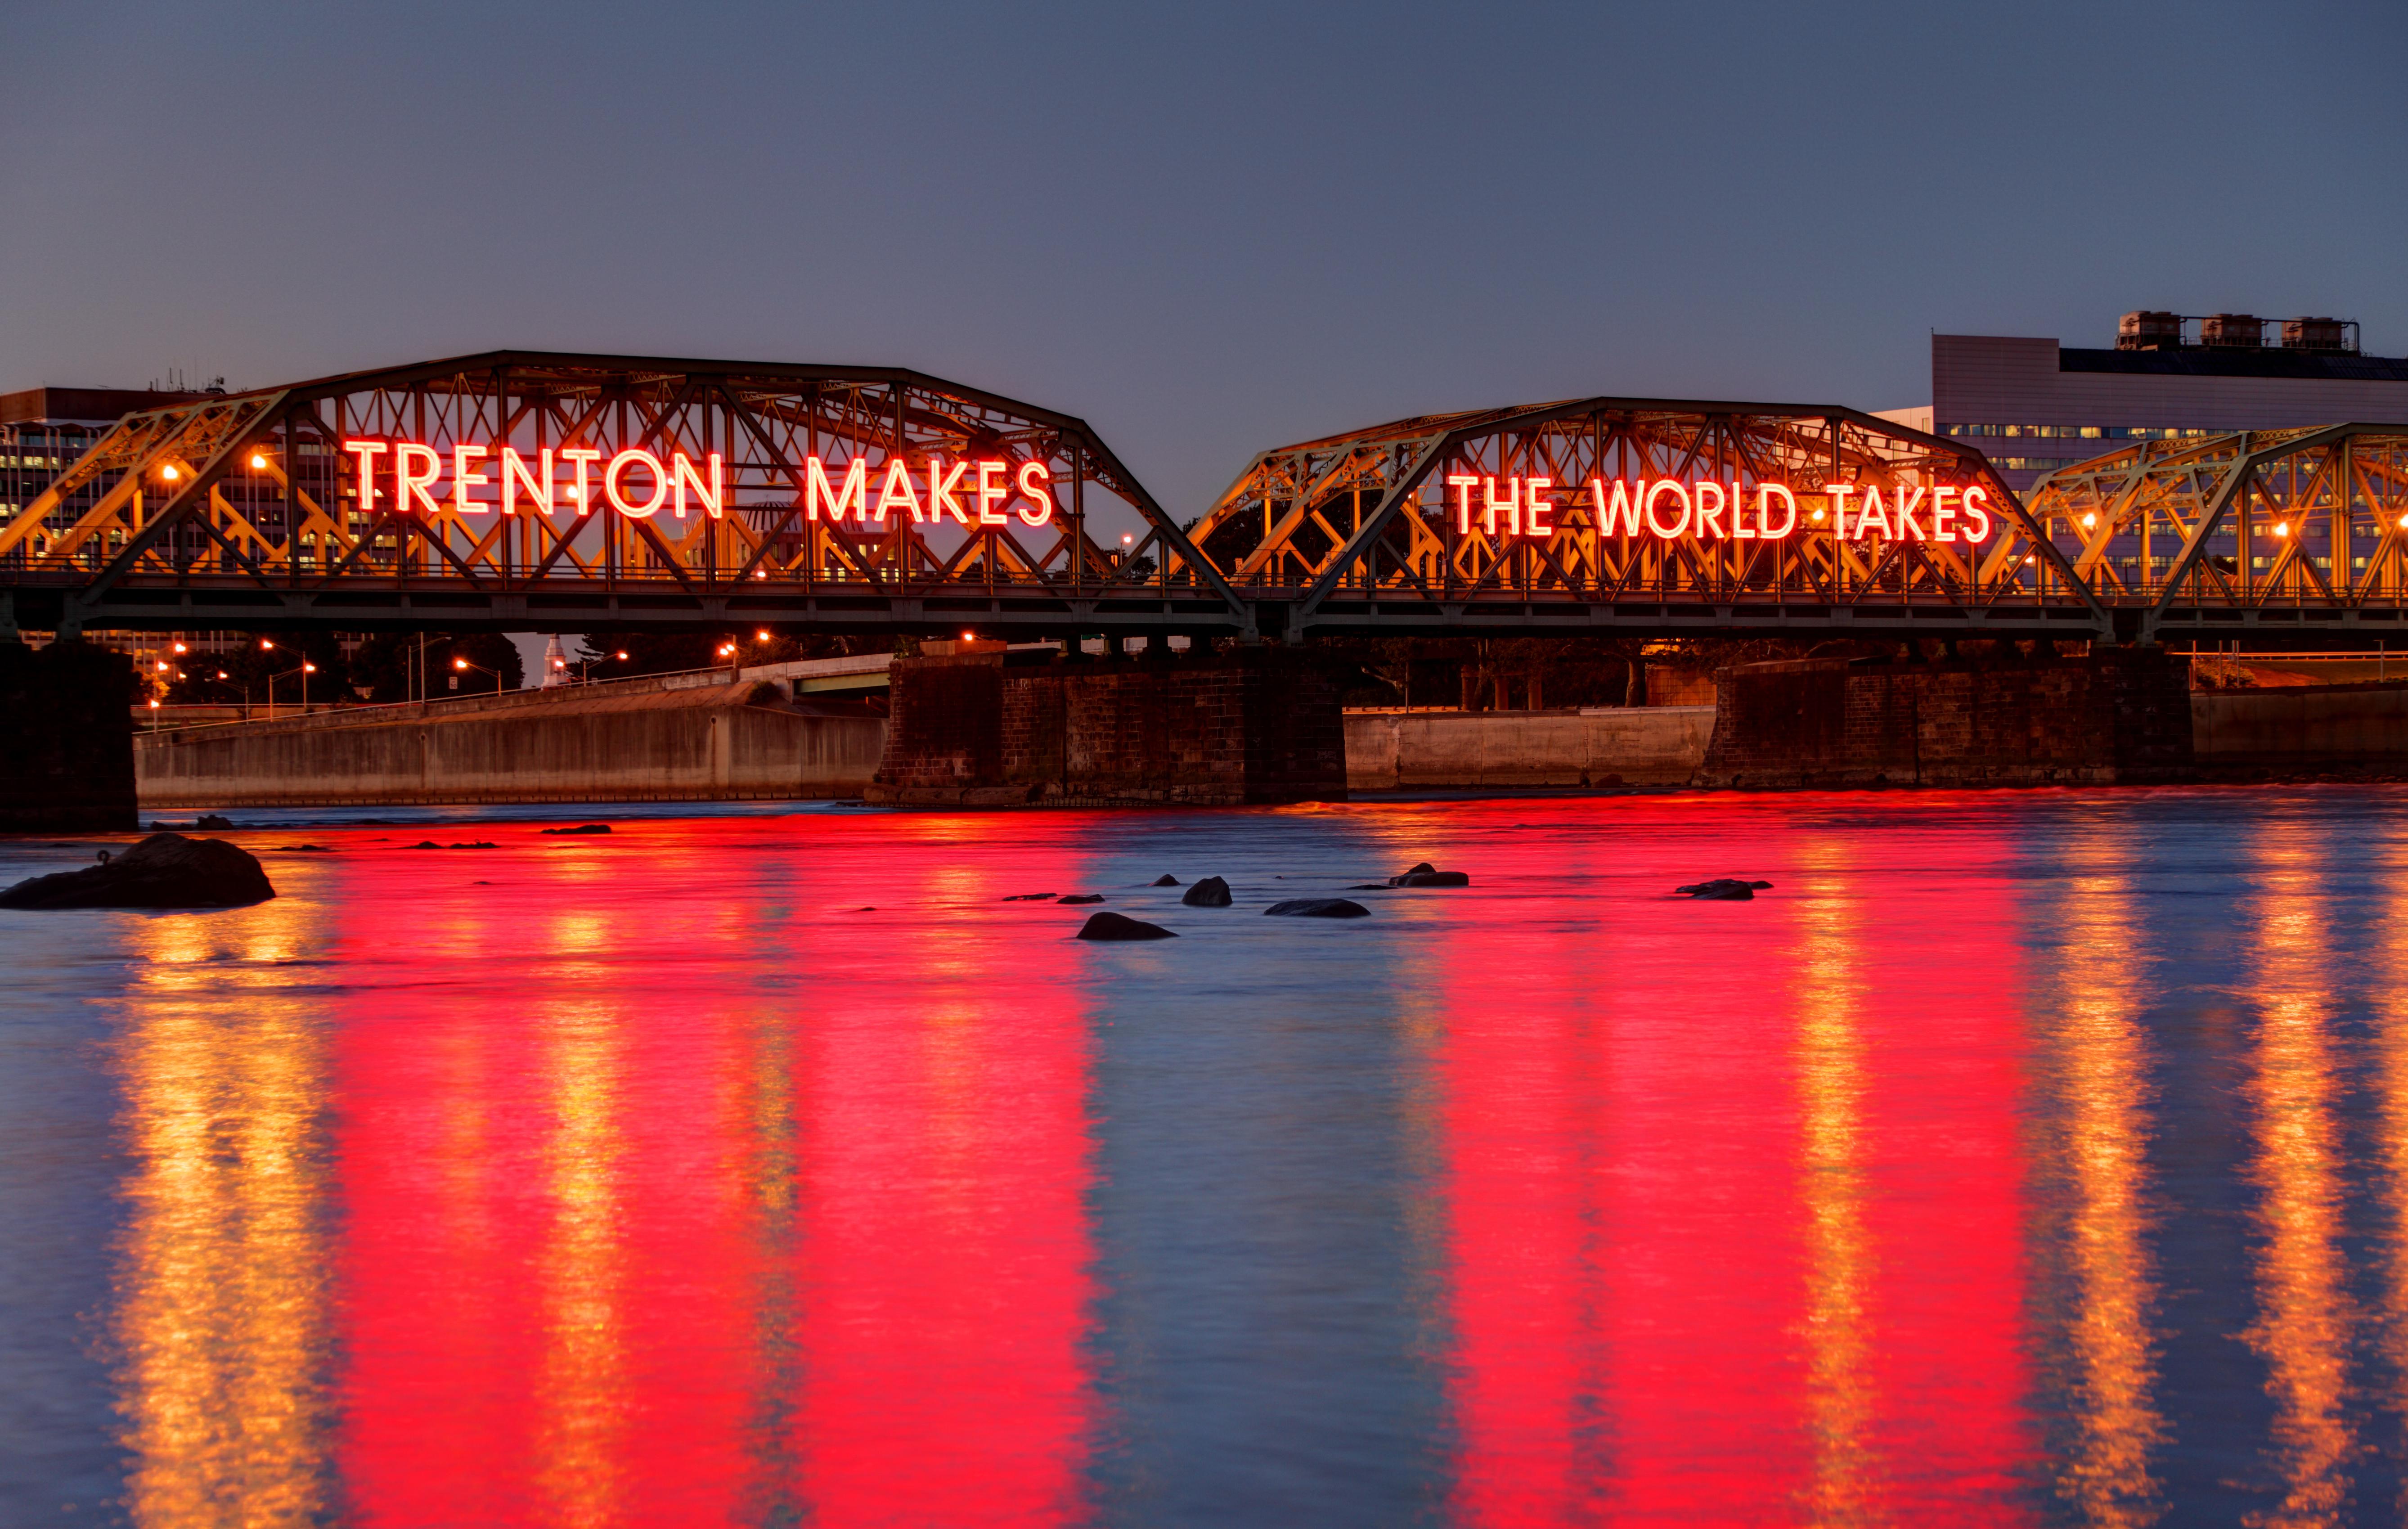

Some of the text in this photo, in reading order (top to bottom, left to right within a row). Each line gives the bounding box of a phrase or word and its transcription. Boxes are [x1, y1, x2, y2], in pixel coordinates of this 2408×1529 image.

[346, 441, 1052, 526] TRENTON MAKES
[1448, 475, 1989, 543] THE WORLD TAKES
